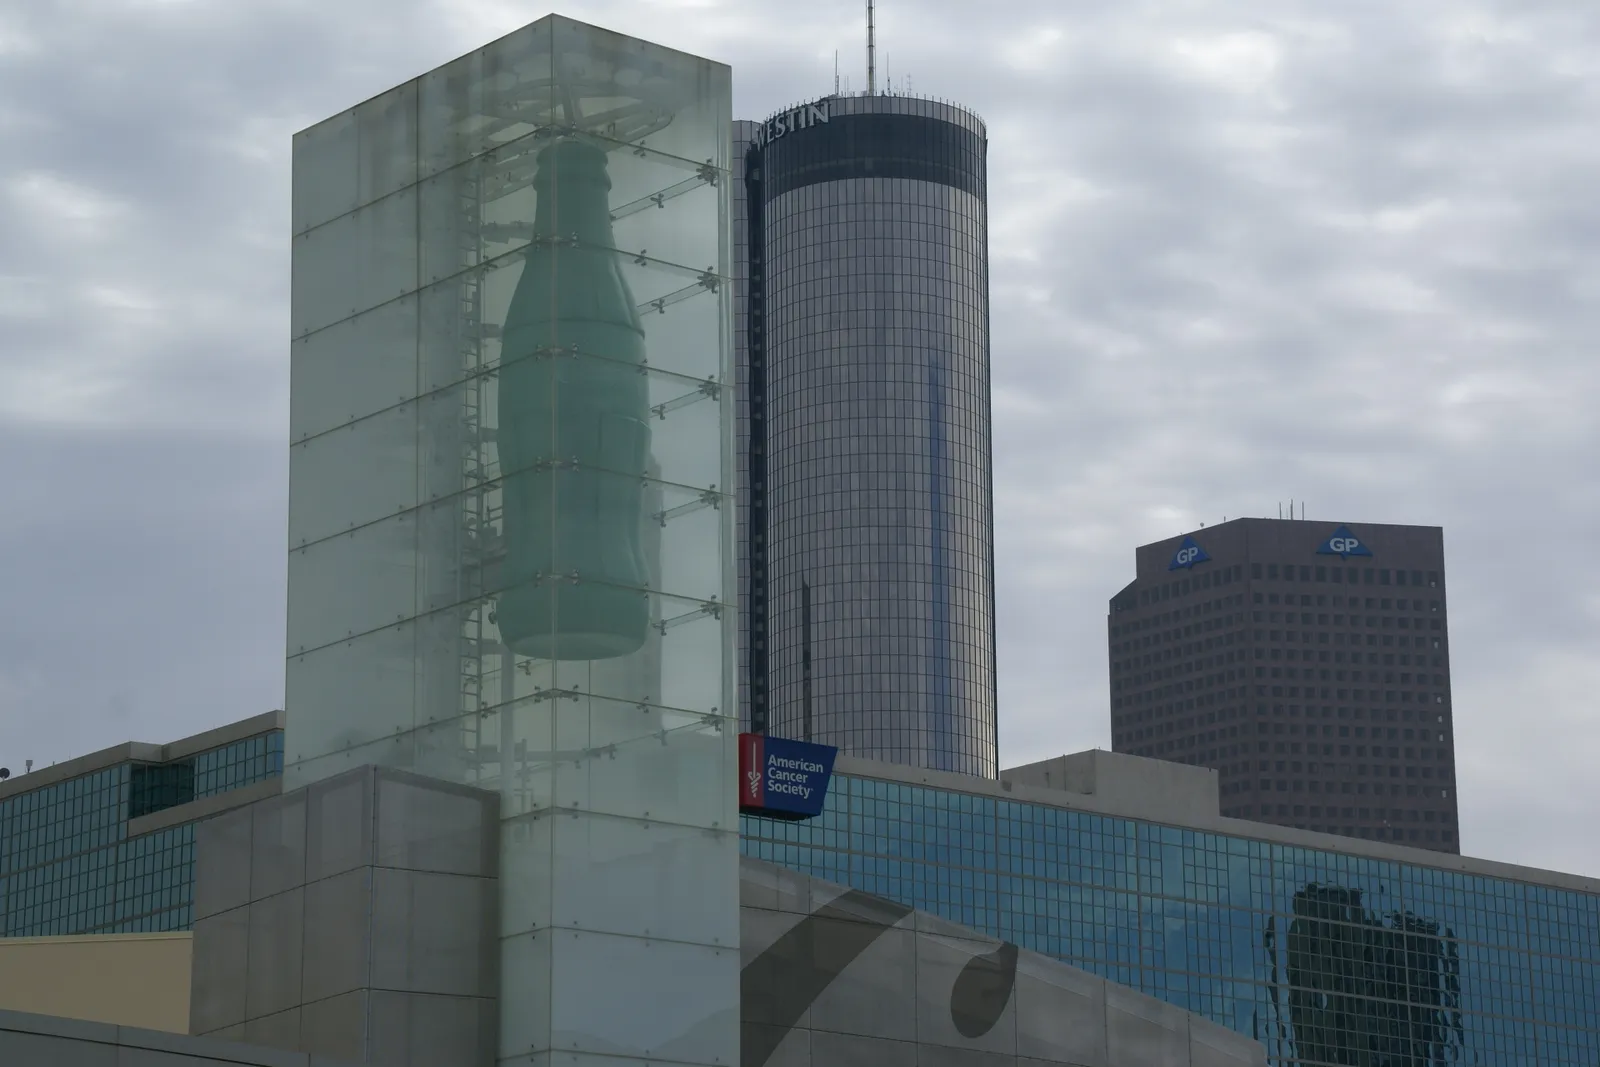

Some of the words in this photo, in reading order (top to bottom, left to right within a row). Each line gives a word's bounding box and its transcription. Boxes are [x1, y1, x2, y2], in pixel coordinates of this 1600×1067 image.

[756, 101, 830, 151] WESTIN
[1329, 538, 1358, 552] GP
[1177, 547, 1199, 564] GP
[768, 755, 823, 773] American
[768, 767, 808, 783] Cancer
[768, 780, 810, 799] Society
